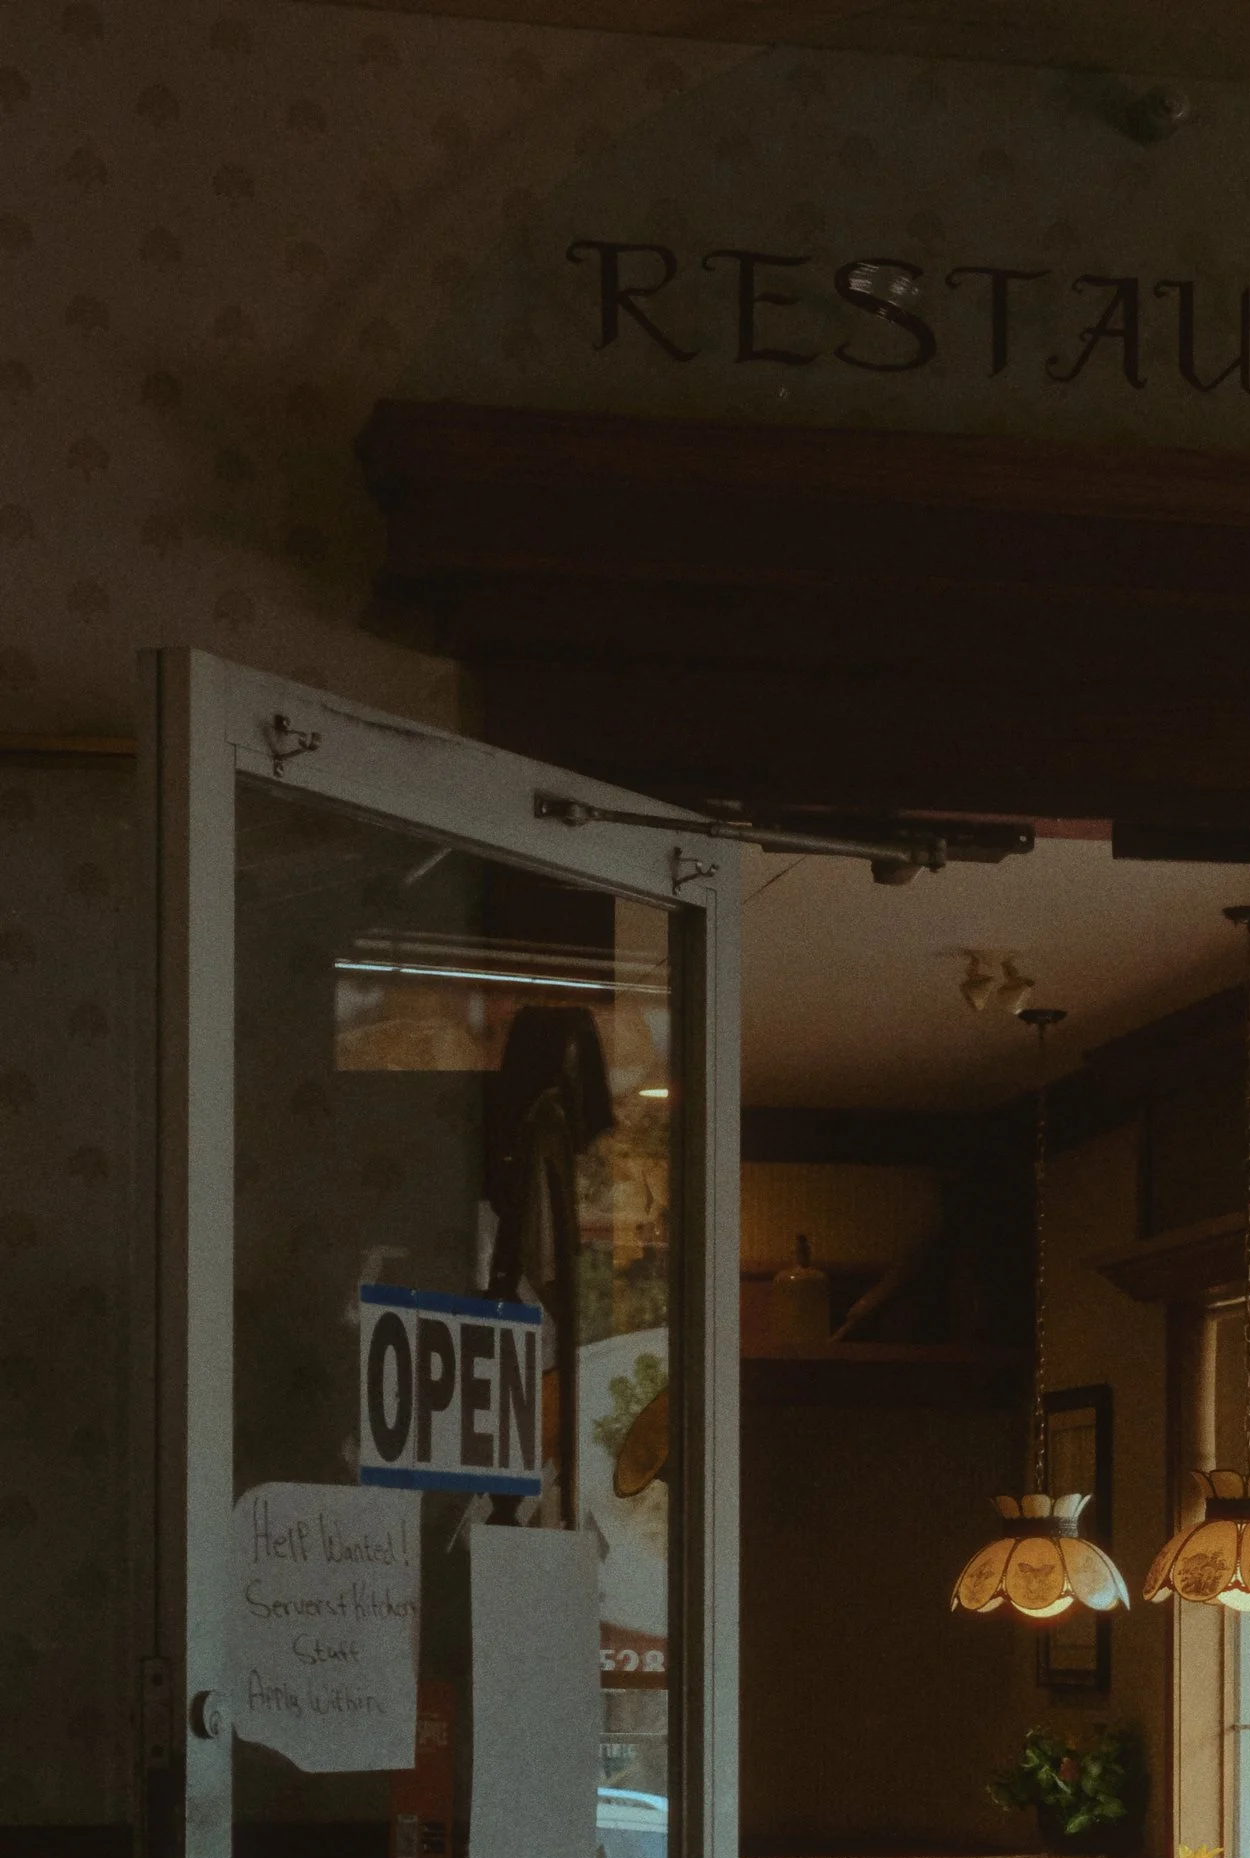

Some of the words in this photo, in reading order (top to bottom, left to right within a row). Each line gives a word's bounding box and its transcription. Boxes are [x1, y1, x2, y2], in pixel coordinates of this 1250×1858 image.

[367, 1311, 537, 1471] OPEN
[253, 1497, 309, 1563] Help
[319, 1512, 409, 1567] Wanted!
[293, 1632, 361, 1665] Staff
